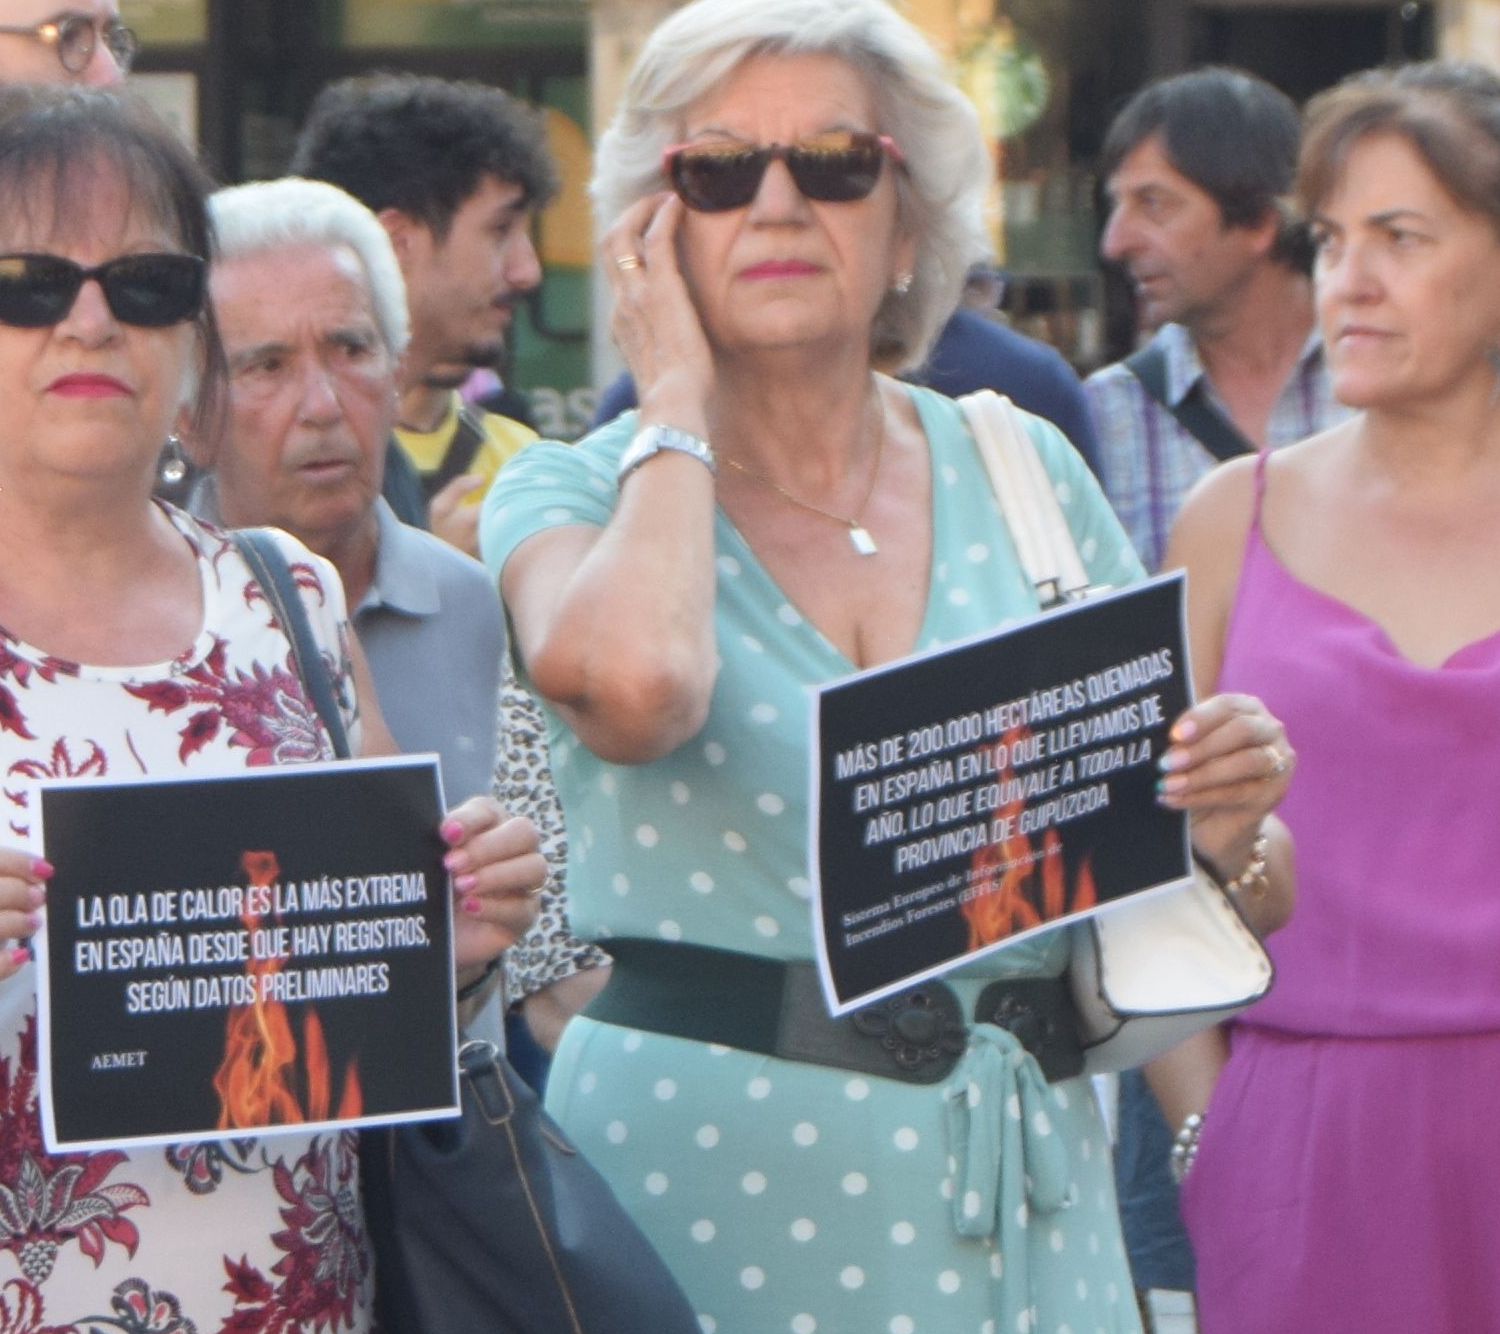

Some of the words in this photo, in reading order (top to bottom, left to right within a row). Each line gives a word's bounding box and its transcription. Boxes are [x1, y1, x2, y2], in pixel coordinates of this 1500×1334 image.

[835, 743, 878, 779] MÁS
[882, 735, 905, 766] DE
[909, 712, 982, 759] 200.000
[985, 679, 1086, 732] HECTÁREAS
[1086, 648, 1173, 702] QUEMADAS
[856, 782, 882, 811] EN
[883, 759, 955, 803] ESPAÑA
[958, 752, 982, 782] EN
[985, 744, 1008, 774] LO
[1011, 735, 1046, 767] QUE
[1048, 704, 1140, 755] LLEVAMOS
[1142, 694, 1166, 726] DE
[865, 809, 908, 846] AÑO,
[911, 802, 934, 831] LO
[936, 791, 974, 823] QUE
[975, 764, 1060, 812] EQUIVALE
[1060, 760, 1074, 785] A
[1079, 743, 1125, 779] TODA
[1127, 739, 1152, 766] LA
[896, 823, 988, 873] PROVINCIA
[989, 815, 1017, 844] DE
[1019, 783, 1110, 835] GUIPÚZCOA
[78, 896, 105, 928] LA
[109, 894, 148, 925] OLA
[152, 892, 178, 922] DE
[181, 888, 244, 921] CALOR
[247, 887, 271, 916] ES
[274, 884, 298, 914] LA
[302, 875, 342, 911] MÁS
[345, 872, 427, 908] EXTREMA
[75, 942, 102, 972] EN
[107, 933, 184, 970] ESPAÑA
[190, 931, 249, 964] DESDE
[250, 927, 290, 960] QUE
[291, 925, 332, 956] HAY
[335, 916, 431, 954] REGISTROS,
[127, 975, 190, 1013] SEGÚN
[194, 975, 257, 1008] DATOS
[261, 963, 390, 1003] PRELIMINARES
[91, 1051, 148, 1070] AEMET
